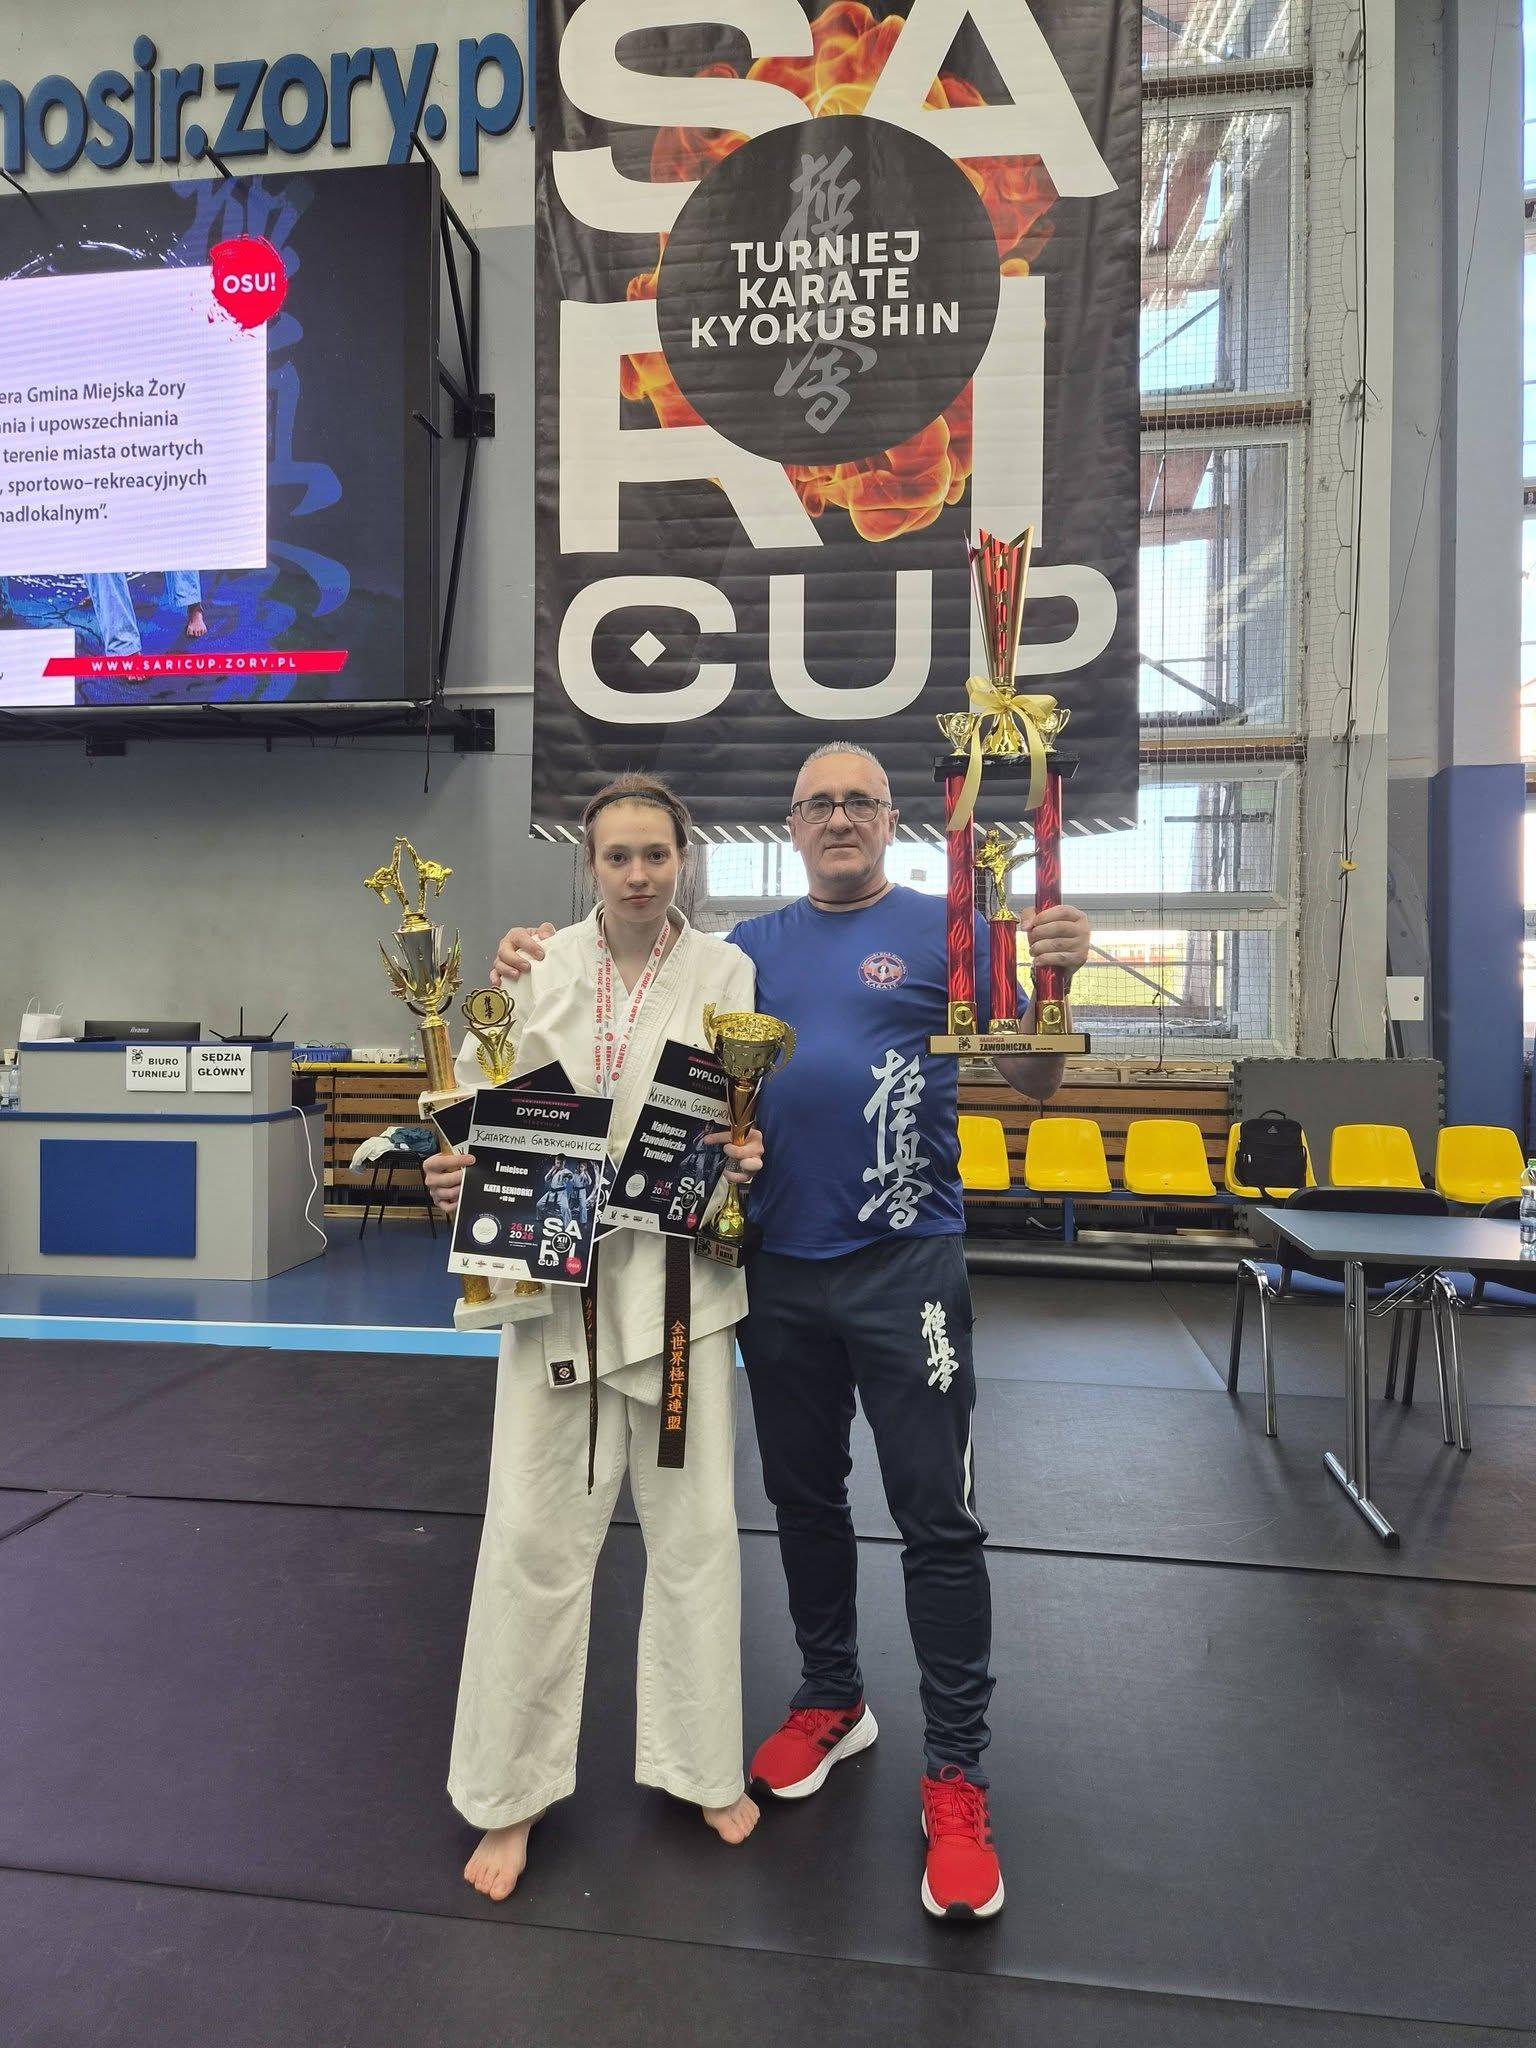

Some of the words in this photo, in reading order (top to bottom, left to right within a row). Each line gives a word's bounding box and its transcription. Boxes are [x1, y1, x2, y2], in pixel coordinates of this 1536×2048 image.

[552, 0, 1120, 234] SA
[730, 230, 920, 273] TURNIEJ
[222, 271, 277, 295] OSU!
[739, 267, 910, 309] KARATE
[691, 301, 960, 349] KYOKUSHIN
[27, 386, 78, 403] Gmina
[83, 381, 144, 402] Miejska
[148, 377, 186, 400] Żory
[0, 417, 26, 434] nia
[30, 416, 35, 433] i
[38, 410, 178, 435] upowszechniania
[3, 446, 59, 463] terenie
[63, 444, 116, 461] miasta
[120, 438, 204, 460] otwartych
[558, 563, 1118, 725] CUP
[91, 657, 297, 672] WWW.SARICUP.ZORY.PL
[627, 1005, 639, 1024] SARI
[634, 989, 644, 1004] CUP
[640, 972, 652, 989] 2026
[595, 1005, 603, 1024] SARI
[615, 1043, 627, 1069] BEBETO
[979, 1042, 1032, 1052] ZAWODNICZKA
[148, 1058, 179, 1066] BIURO
[201, 1053, 242, 1064] SĘDZIA
[131, 1070, 181, 1078] TURNIEJU
[197, 1066, 246, 1077] GŁÓWNY
[688, 1066, 729, 1087] DYPLOM
[648, 1087, 687, 1110] KATARZYNA
[516, 1106, 571, 1120] DYPLOM
[650, 1120, 688, 1139] Najlepsza
[473, 1129, 526, 1145] KATARZYNA
[531, 1133, 602, 1152] GABRYCHOWICZ
[639, 1132, 687, 1152] Zawodniczka
[642, 1147, 674, 1163] Turnieju
[483, 1183, 501, 1194] KATA
[501, 1185, 534, 1197] SENIORKI
[667, 1213, 683, 1221] CUP
[509, 1230, 534, 1241] 2026
[510, 1222, 534, 1233] 26.IX
[542, 1217, 583, 1240] SA
[556, 1235, 568, 1244] XII
[537, 1259, 560, 1267] CUP
